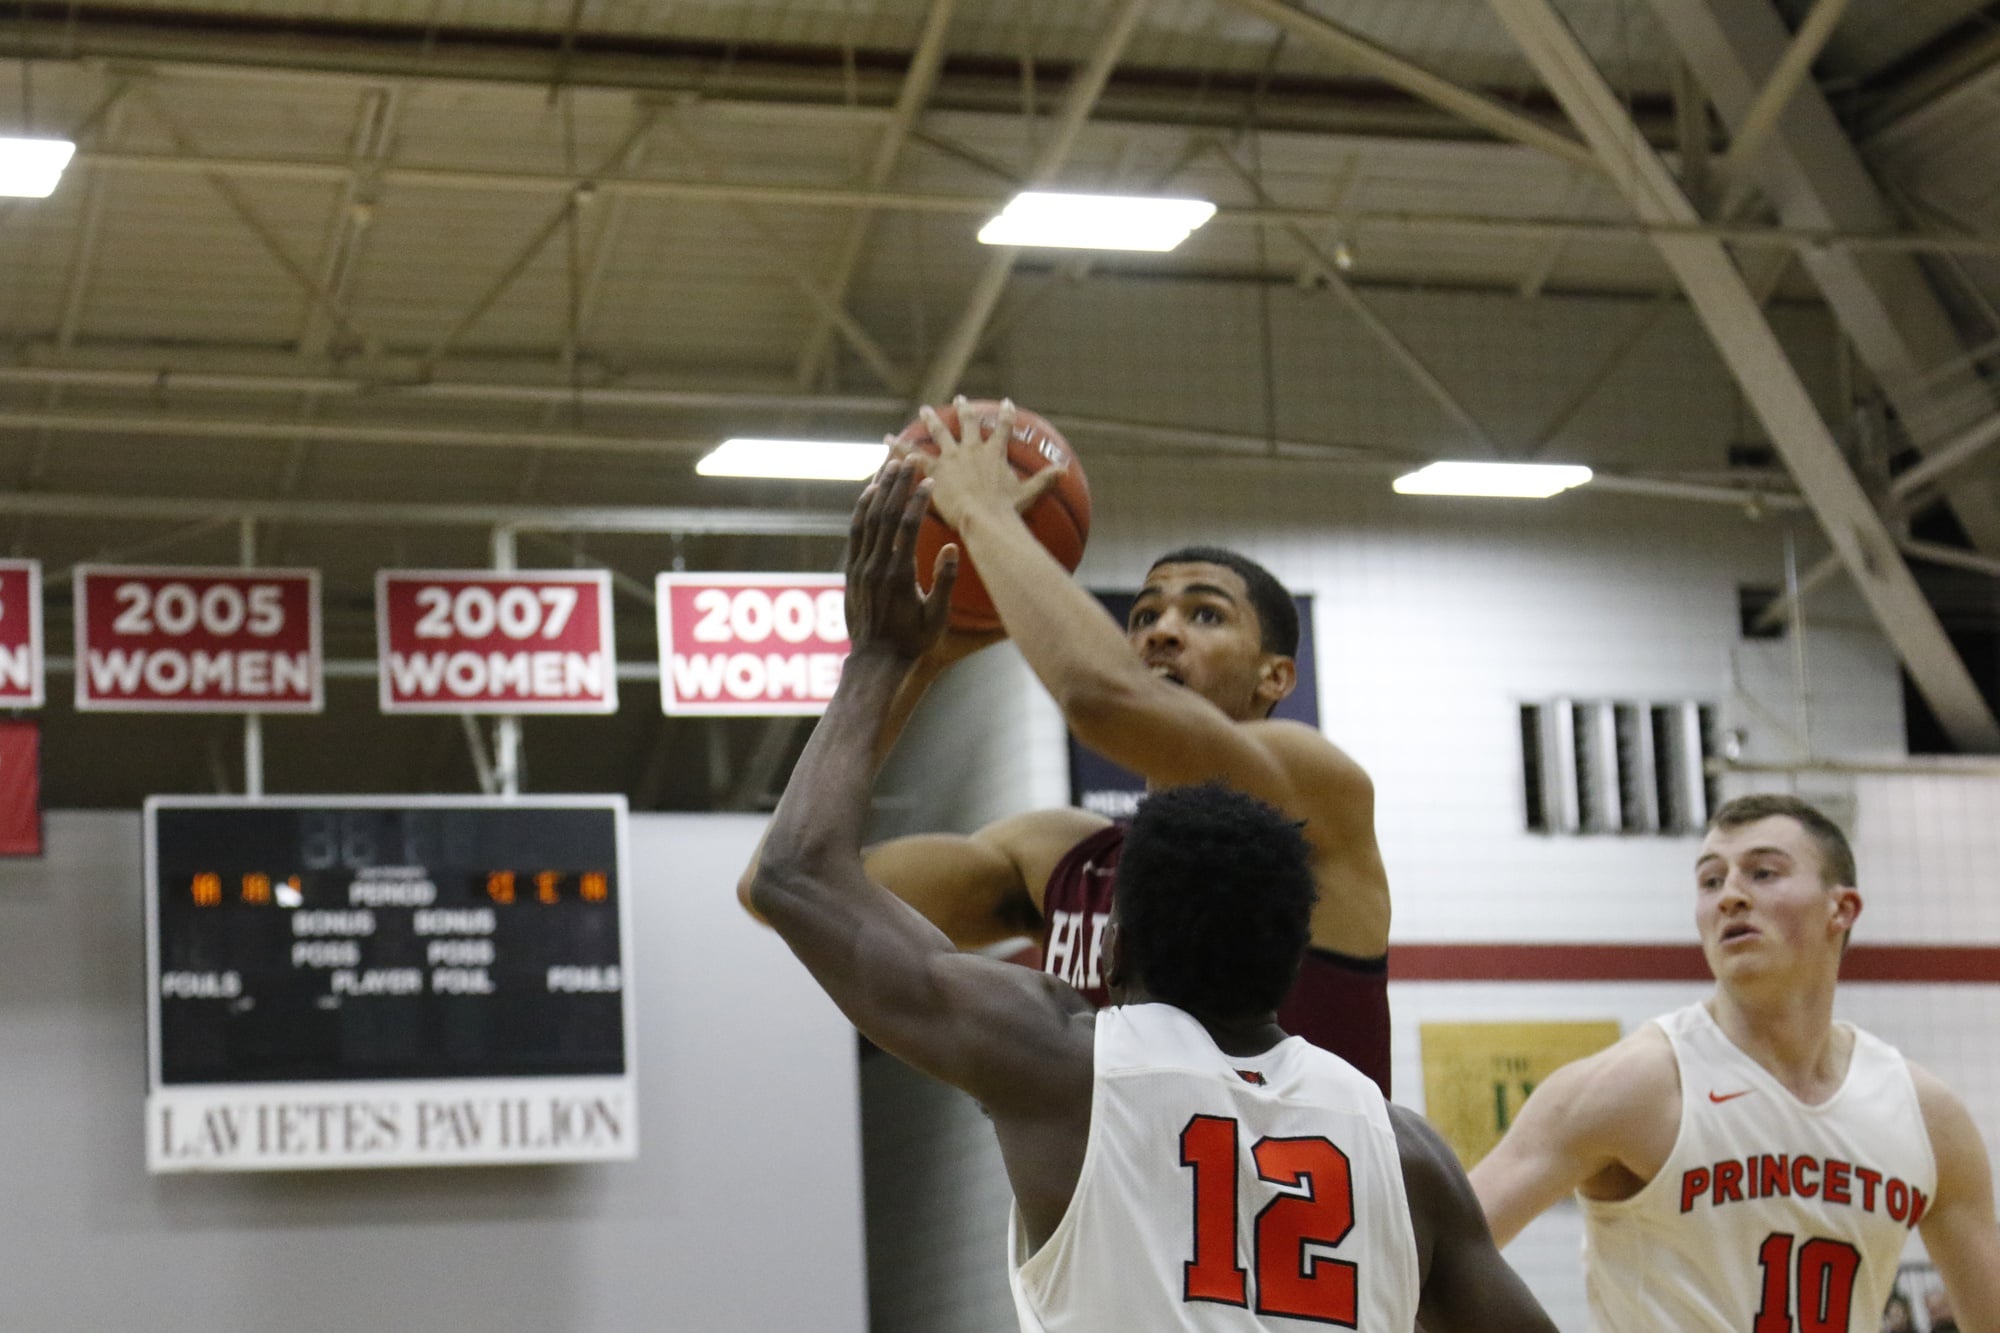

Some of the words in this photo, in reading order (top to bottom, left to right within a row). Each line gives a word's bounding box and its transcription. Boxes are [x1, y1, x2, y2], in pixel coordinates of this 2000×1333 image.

[113, 583, 284, 636] 2005
[414, 586, 578, 639] 2007
[693, 588, 848, 643] 2008
[88, 649, 310, 695] WOMEN
[390, 651, 604, 697] WOMEN
[674, 652, 847, 699] WOME
[159, 1103, 400, 1158] LAVIETES
[416, 1098, 624, 1153] PAVILION
[1680, 1154, 1928, 1230] PRINCETON
[1179, 1113, 1358, 1330] 12
[1753, 1231, 1862, 1333] 10
